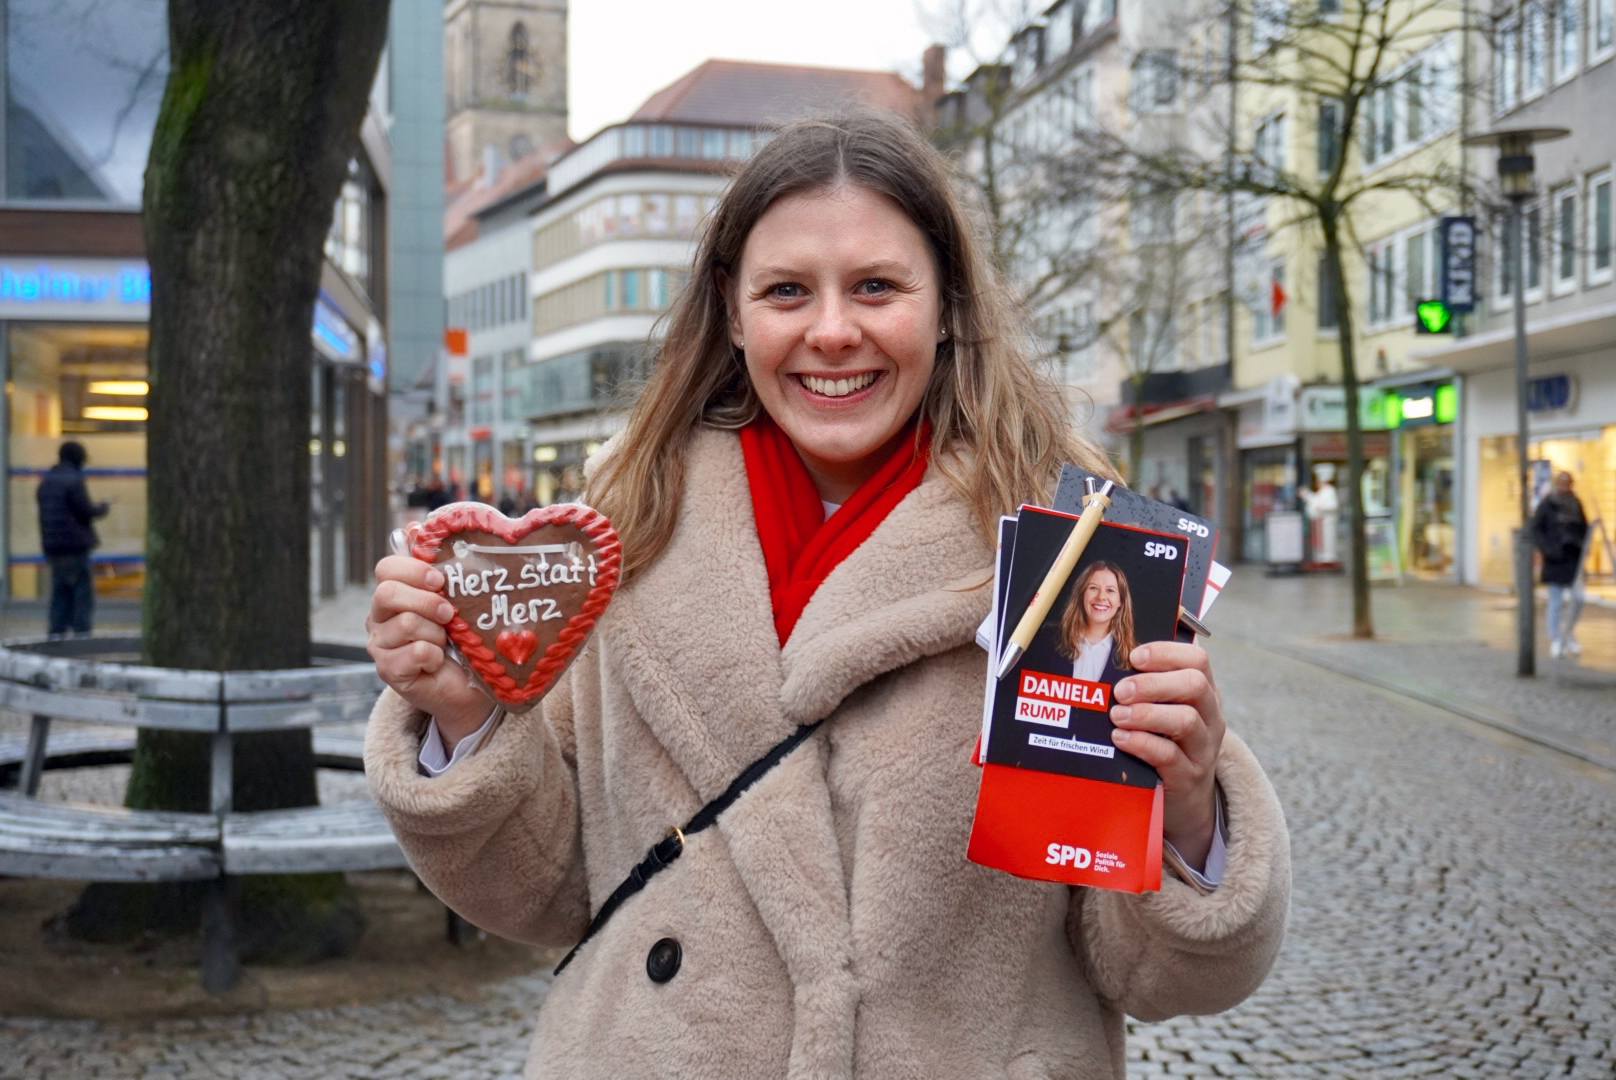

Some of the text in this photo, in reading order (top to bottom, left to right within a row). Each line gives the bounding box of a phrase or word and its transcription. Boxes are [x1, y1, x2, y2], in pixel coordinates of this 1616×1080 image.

[1177, 518, 1209, 538] SPD
[1144, 541, 1177, 560] SPD
[444, 552, 598, 598] Herz statt
[476, 594, 563, 631] Merz
[1022, 675, 1105, 706] DANIELA
[1019, 701, 1067, 722] RUMP
[1033, 736, 1109, 755] Zeit für frischen Wind
[1045, 843, 1091, 869] SPD
[1095, 851, 1118, 861] Soziale
[1095, 858, 1126, 869] Politik für
[1094, 864, 1110, 873] Dich.
